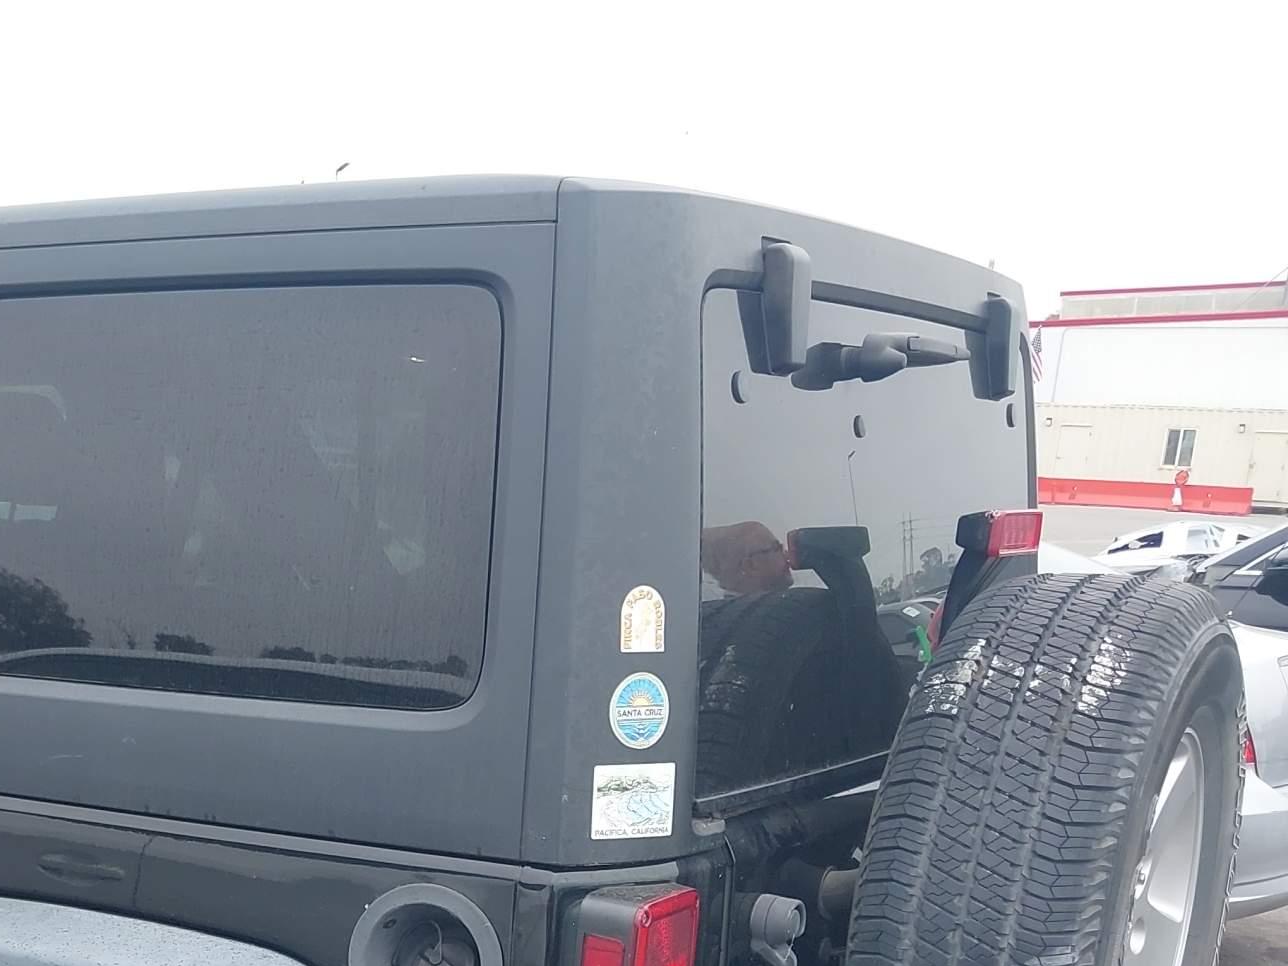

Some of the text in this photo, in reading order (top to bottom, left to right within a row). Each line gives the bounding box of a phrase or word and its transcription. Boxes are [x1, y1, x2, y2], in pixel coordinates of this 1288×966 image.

[617, 708, 664, 718] SANTA CRUZ
[629, 826, 669, 836] CALIFORNIA
